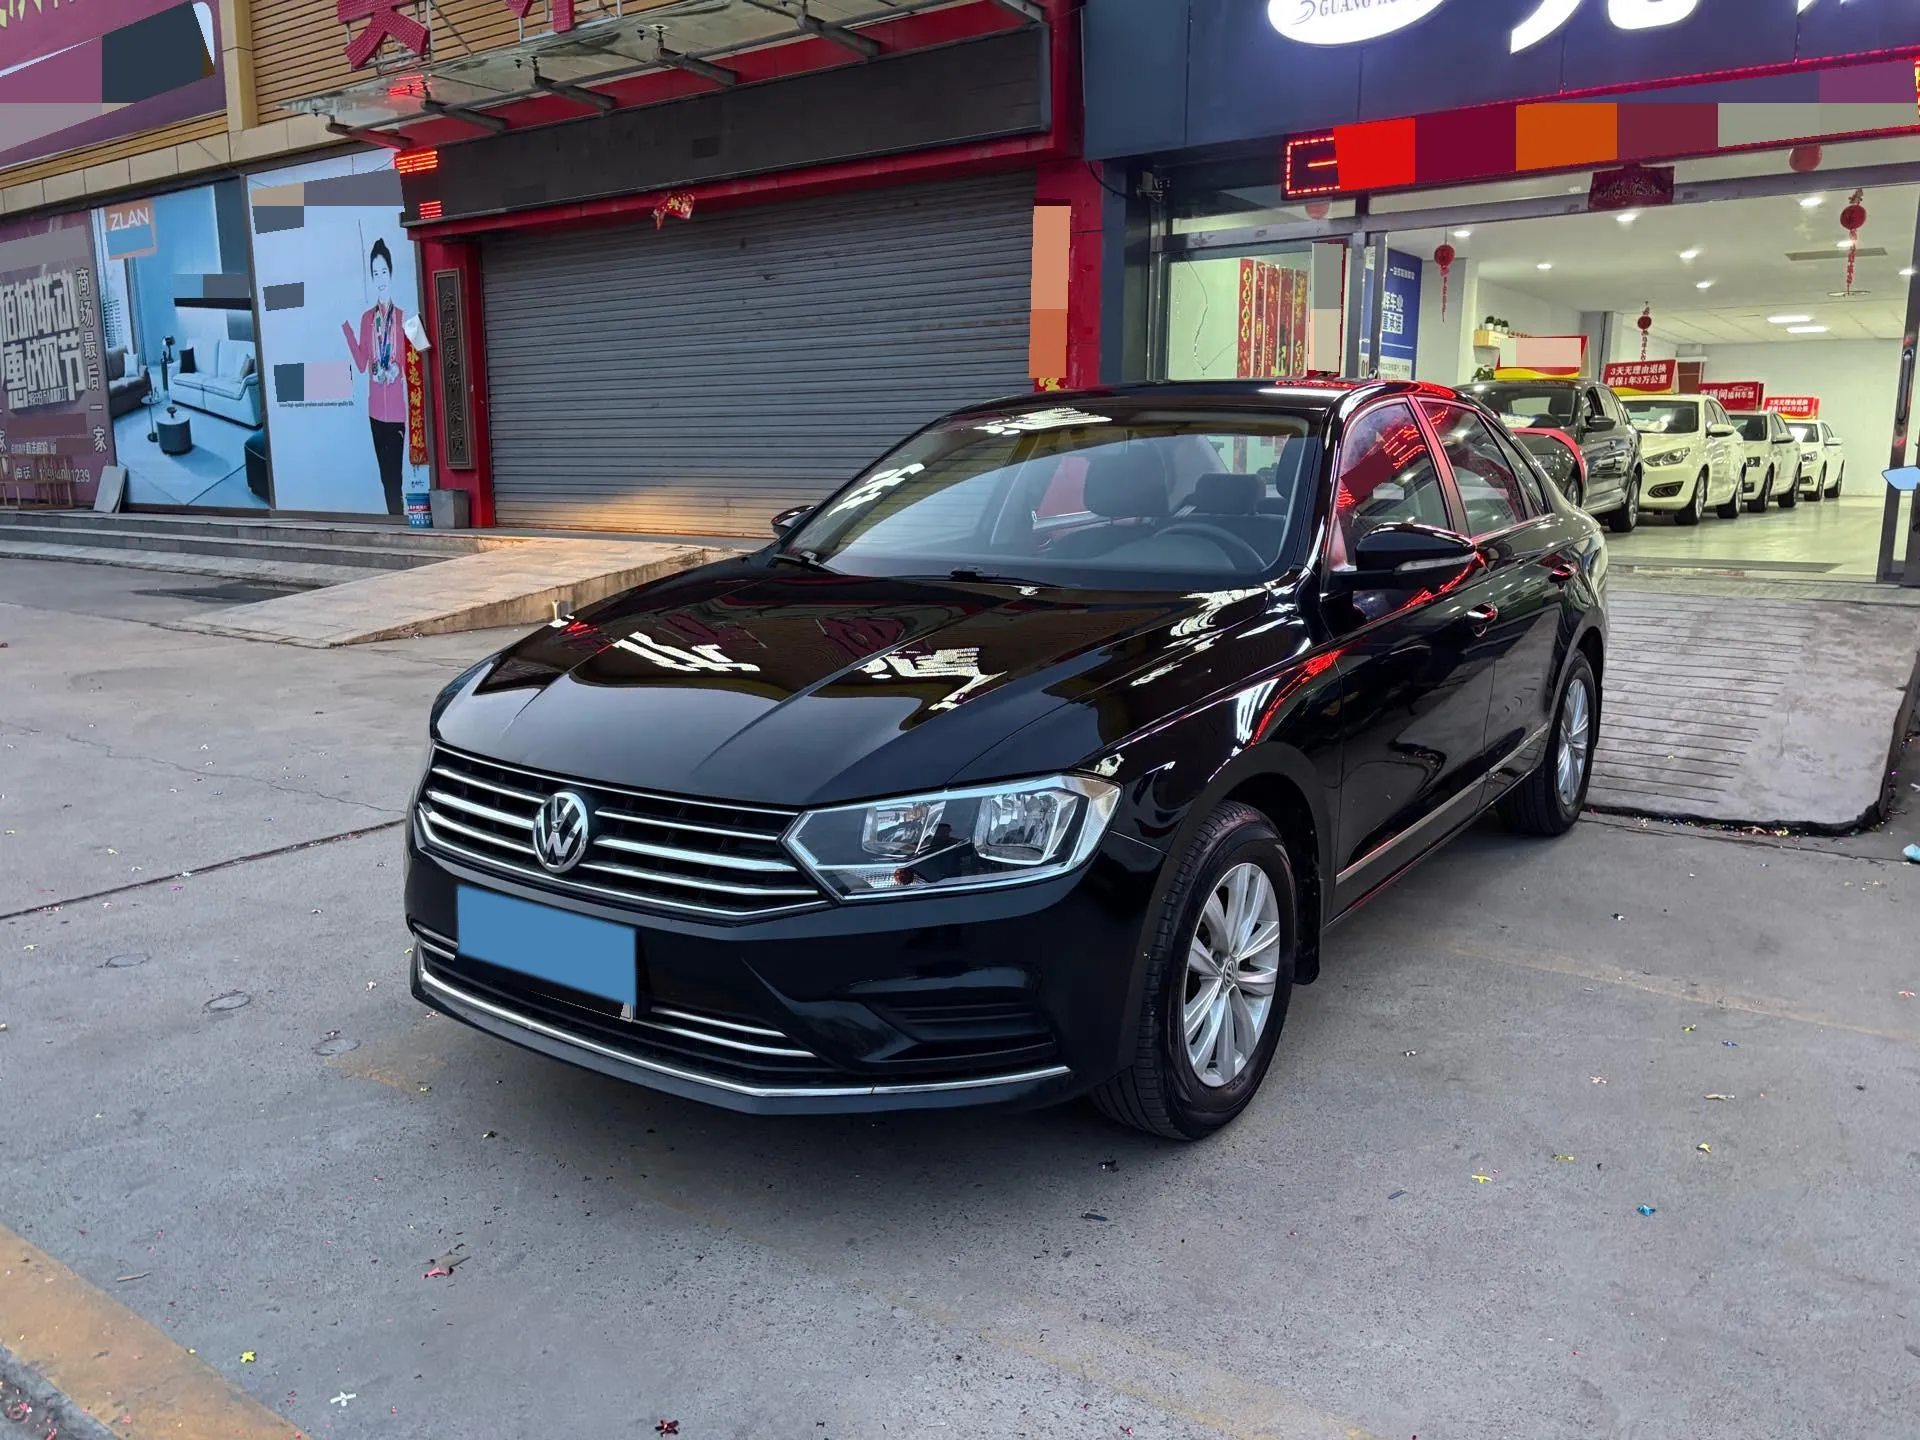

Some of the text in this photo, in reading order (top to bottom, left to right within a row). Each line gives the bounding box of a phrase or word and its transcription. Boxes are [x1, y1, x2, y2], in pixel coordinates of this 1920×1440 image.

[109, 207, 150, 231] ZLAN
[76, 268, 108, 453] 商场最后一家
